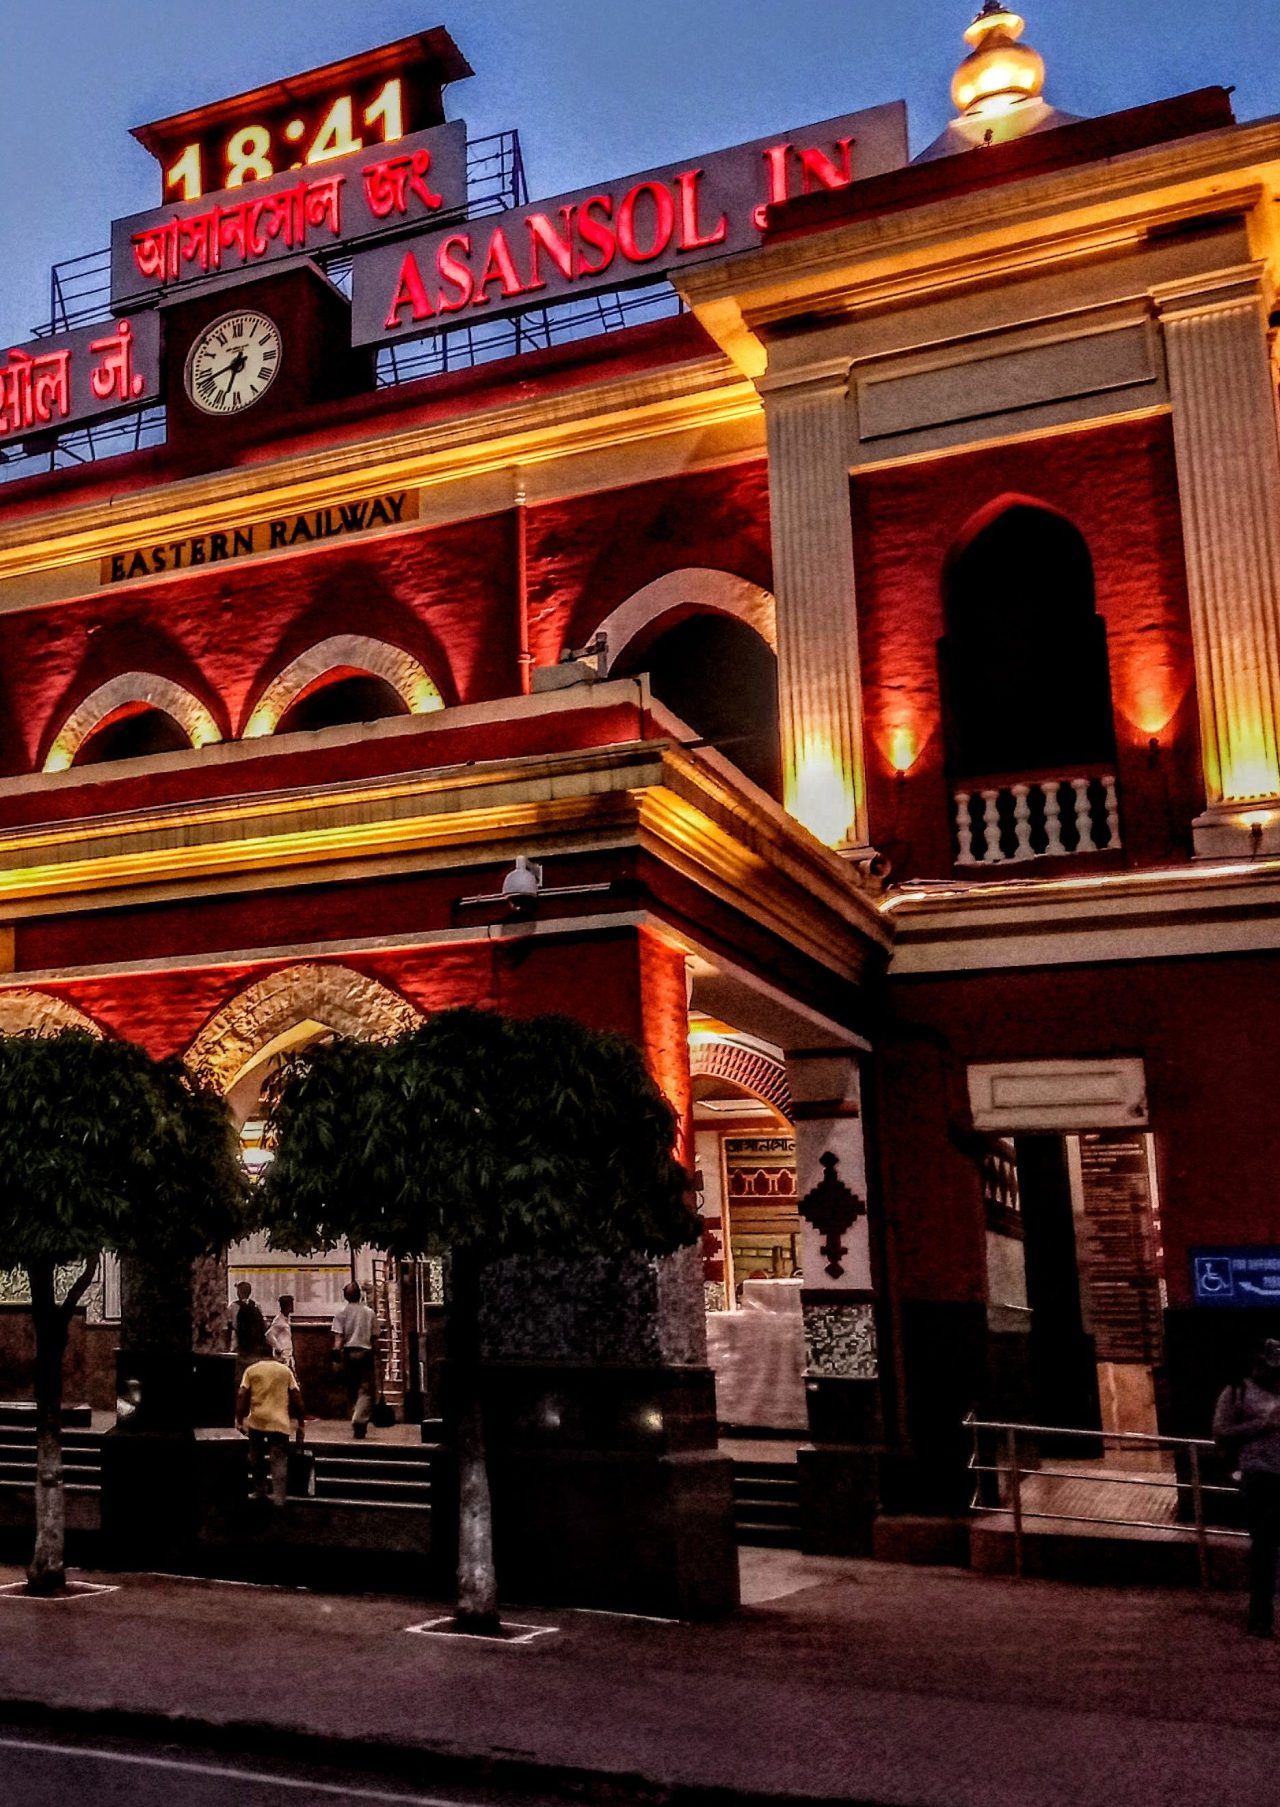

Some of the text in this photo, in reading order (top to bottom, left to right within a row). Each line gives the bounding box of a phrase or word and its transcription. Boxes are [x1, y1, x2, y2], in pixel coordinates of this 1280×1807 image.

[168, 78, 404, 201] 18:41
[131, 174, 347, 285] আসানসোল
[384, 168, 729, 330] ASANSOL
[111, 493, 408, 583] EASTERN RAILWAY
